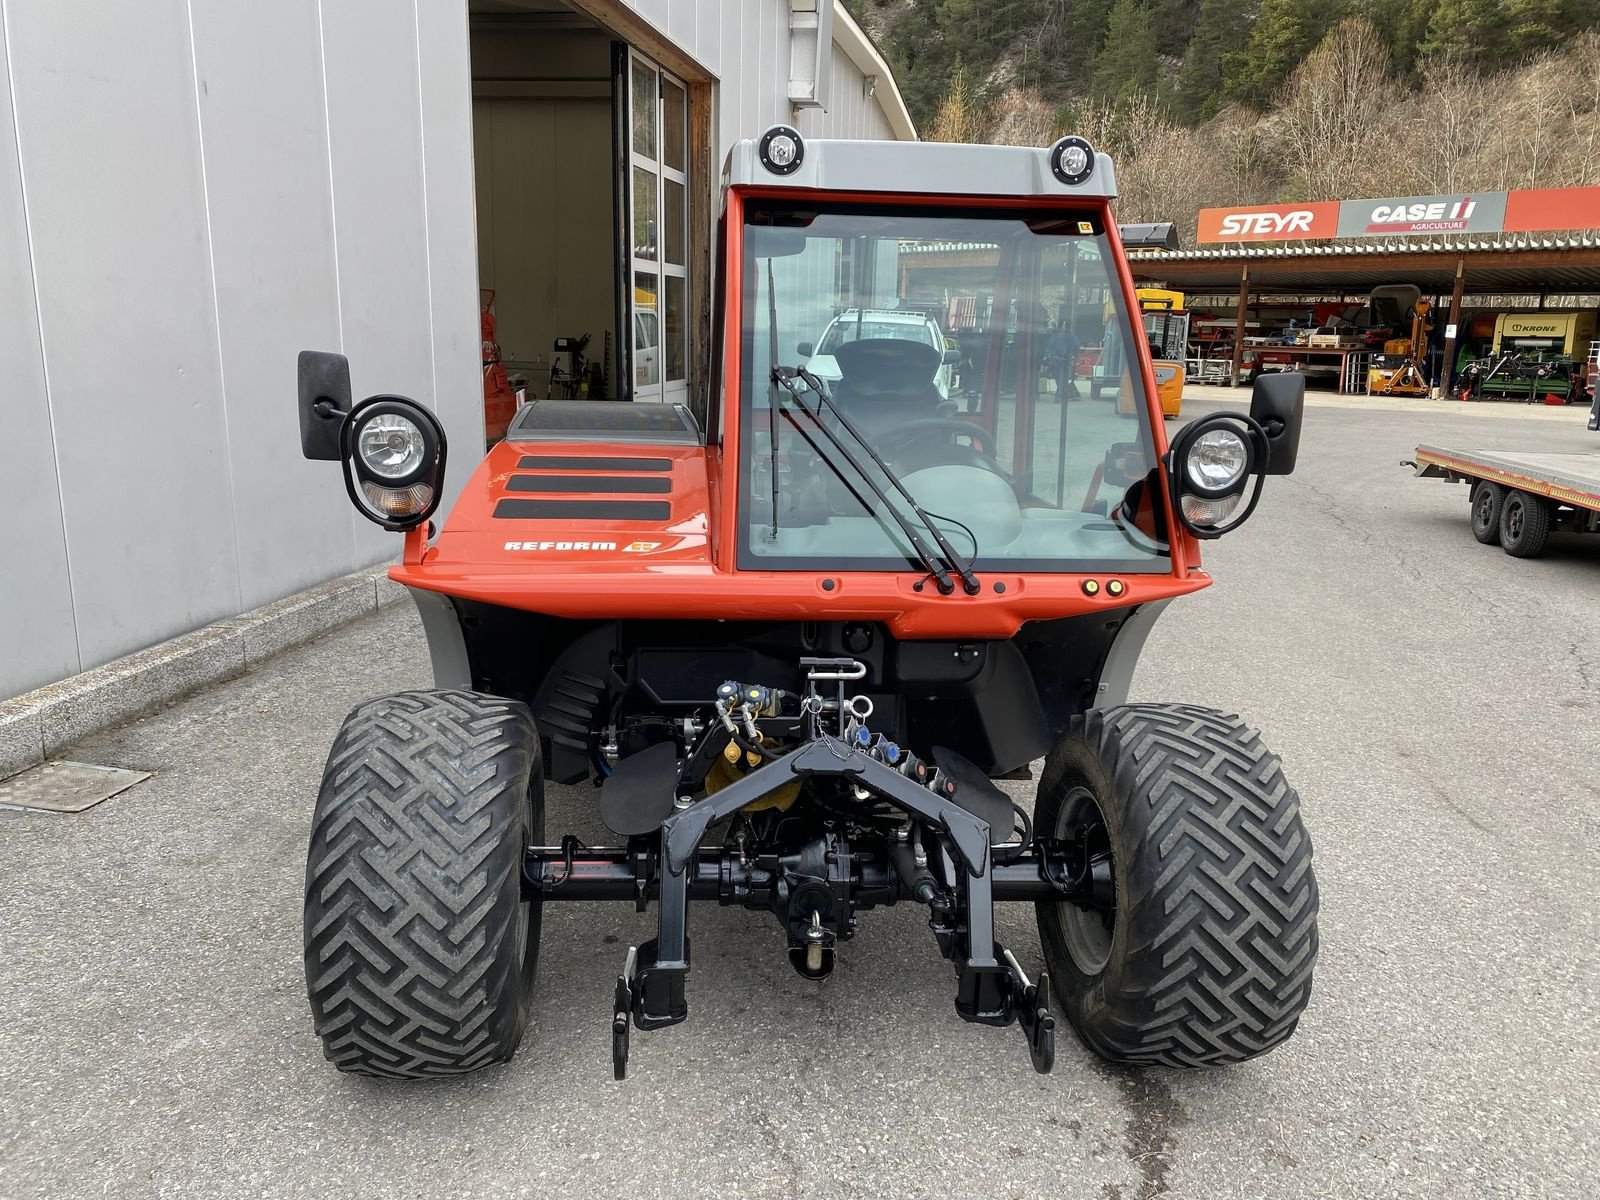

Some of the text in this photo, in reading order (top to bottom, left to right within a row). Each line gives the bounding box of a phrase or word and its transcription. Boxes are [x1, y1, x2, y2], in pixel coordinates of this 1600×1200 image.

[1371, 203, 1447, 223] CASE
[1218, 211, 1314, 235] STEYR
[1410, 221, 1464, 230] AGRICULTURE
[504, 541, 617, 551] REFORM
